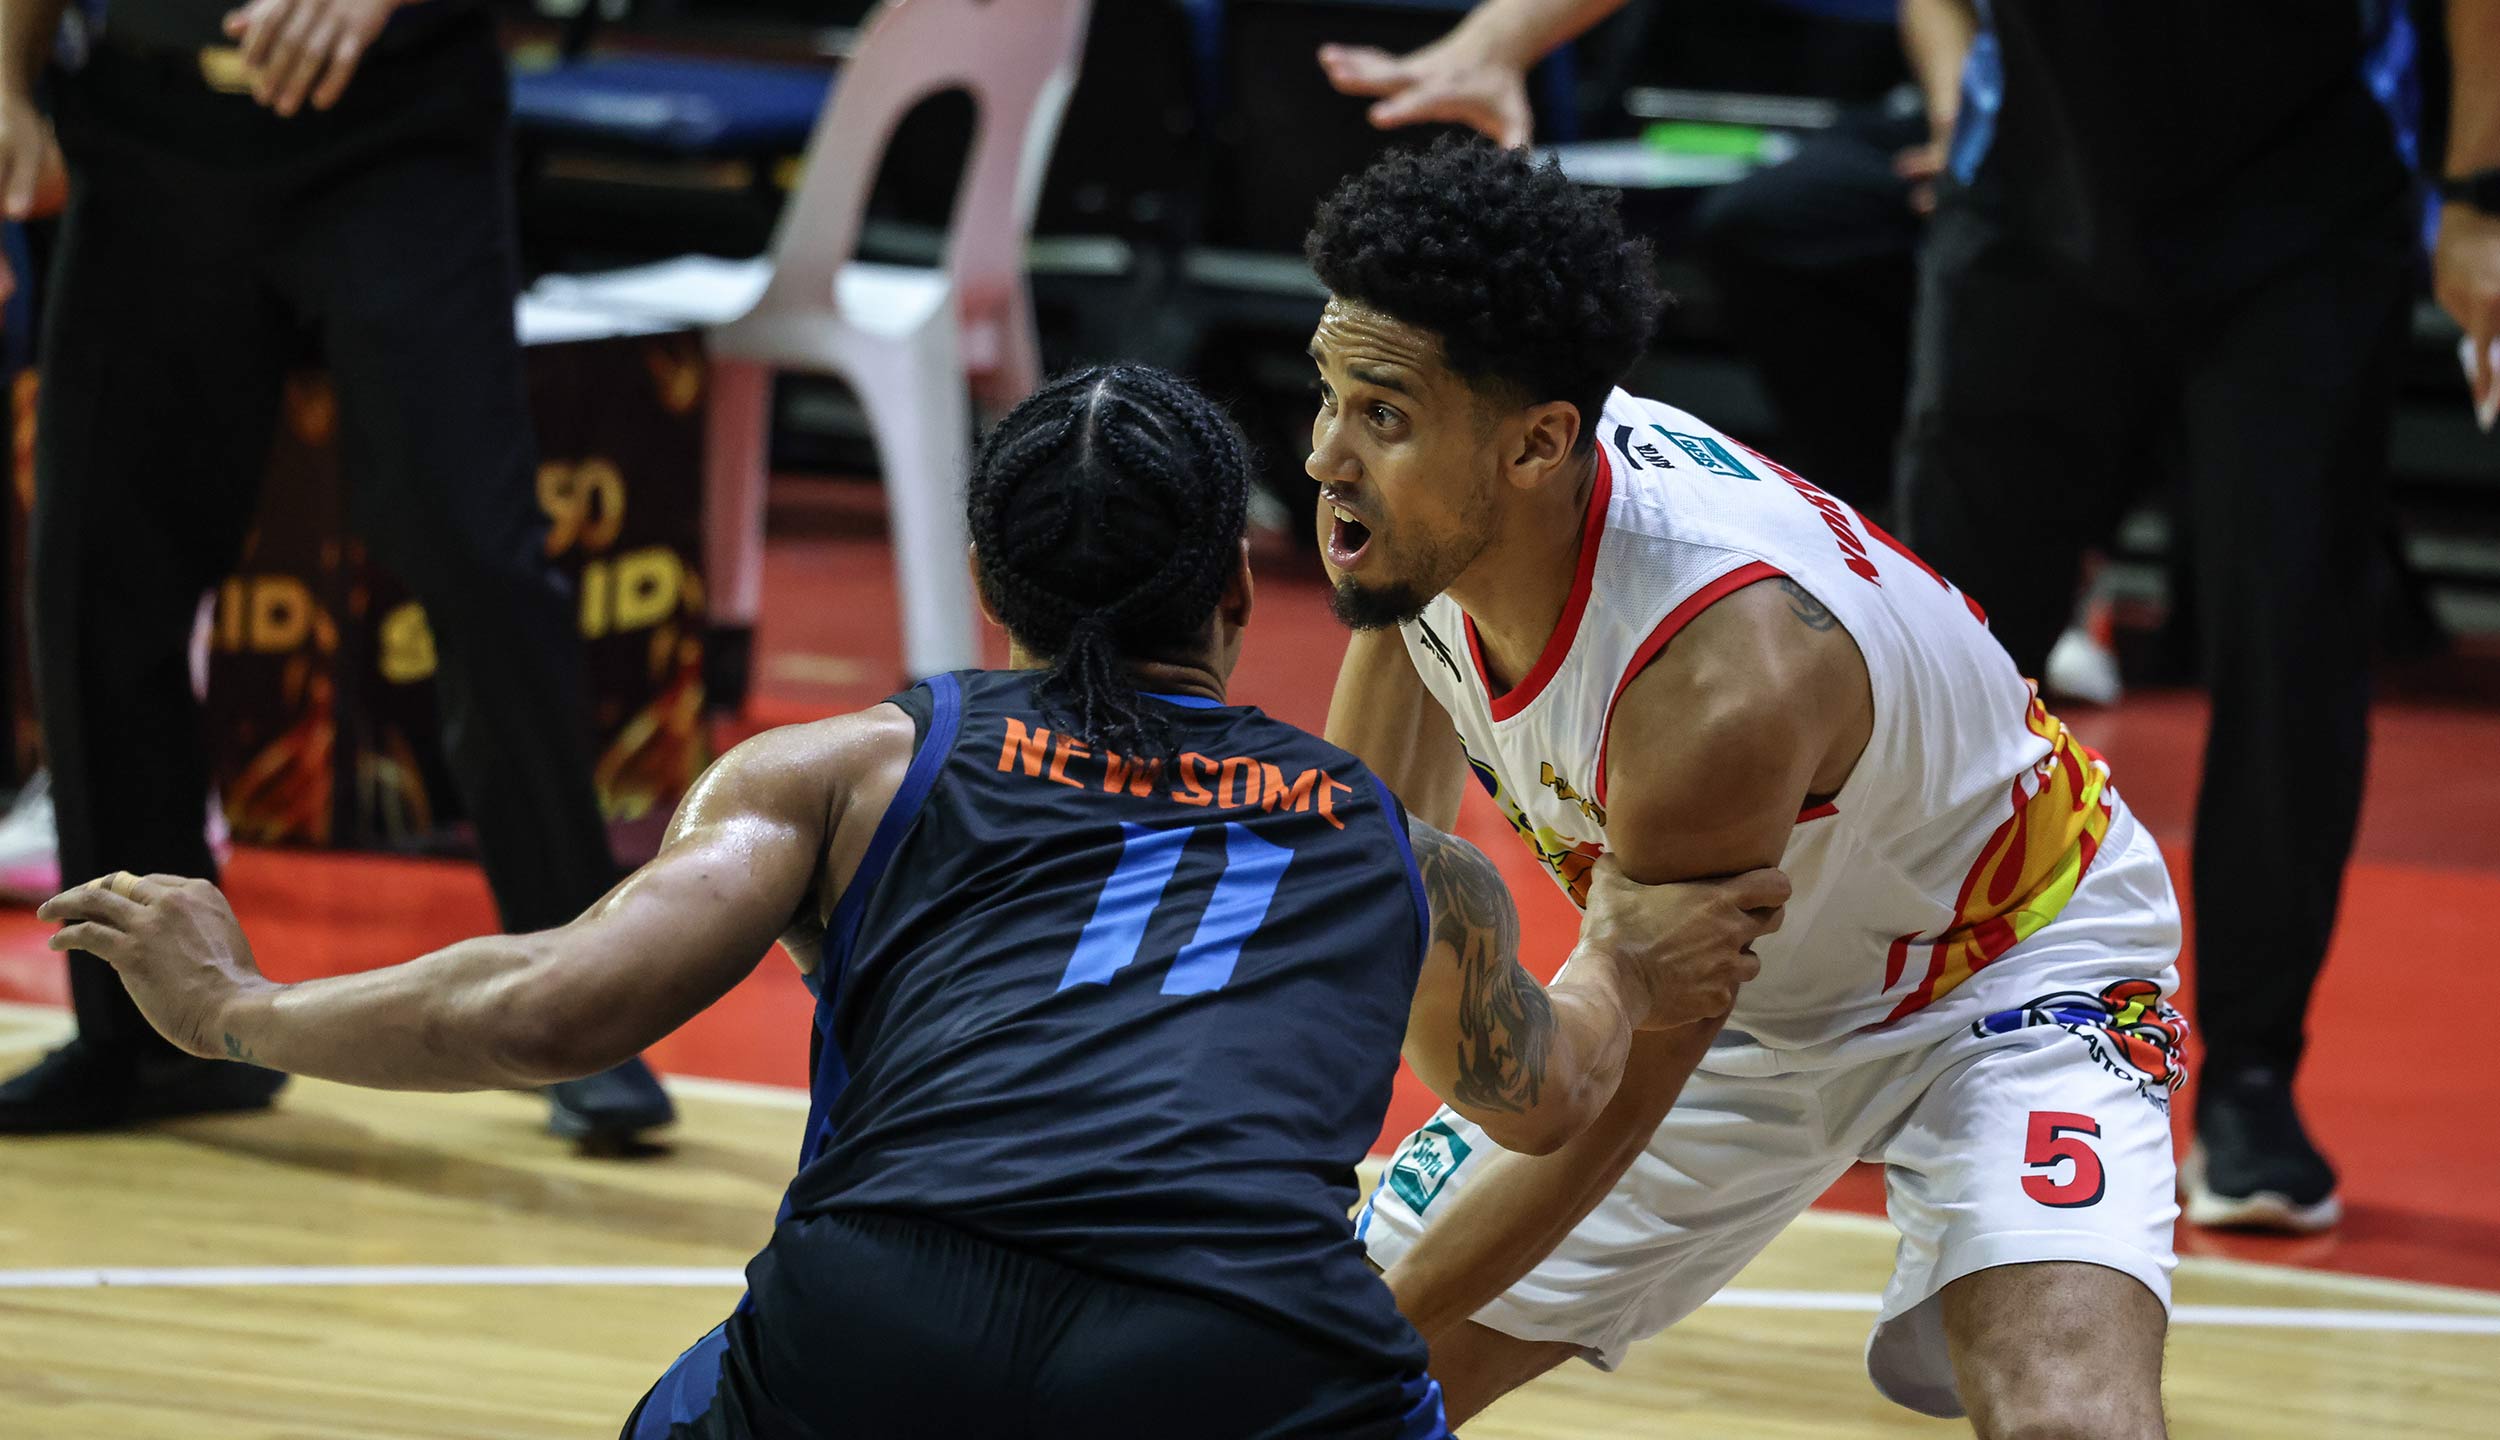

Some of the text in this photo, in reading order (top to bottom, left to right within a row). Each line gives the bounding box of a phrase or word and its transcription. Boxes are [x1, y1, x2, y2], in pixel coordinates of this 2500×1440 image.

[996, 716, 1353, 831] NEWSOME
[1056, 821, 1296, 996] 11
[1412, 1136, 1445, 1179] Sista
[2020, 1110, 2106, 1209] 5
